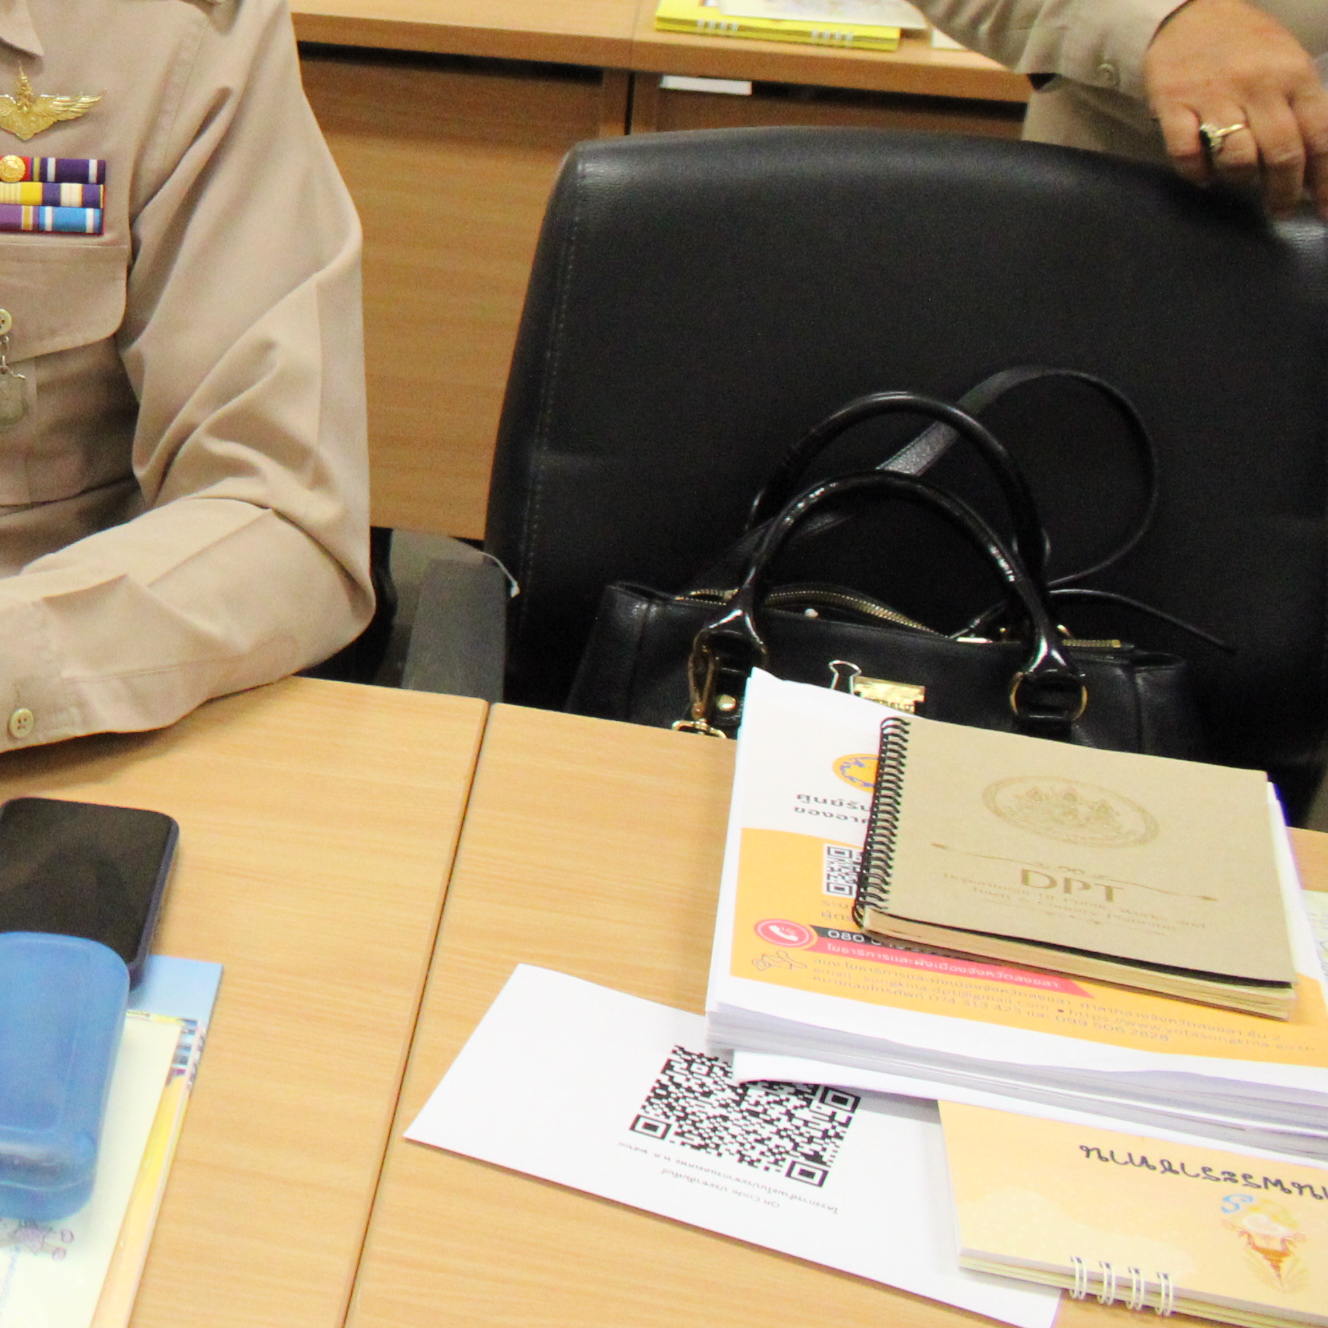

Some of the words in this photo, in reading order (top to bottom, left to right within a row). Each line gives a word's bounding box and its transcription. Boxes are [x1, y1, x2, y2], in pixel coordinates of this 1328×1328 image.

[1019, 868, 1126, 903] DPT
[828, 929, 865, 943] 080
[826, 942, 1061, 990] โยธาธิการและผังเมืองจังหวัดสงขลา
[1055, 1014, 1088, 1029] 099
[1130, 1027, 1170, 1043] 2828
